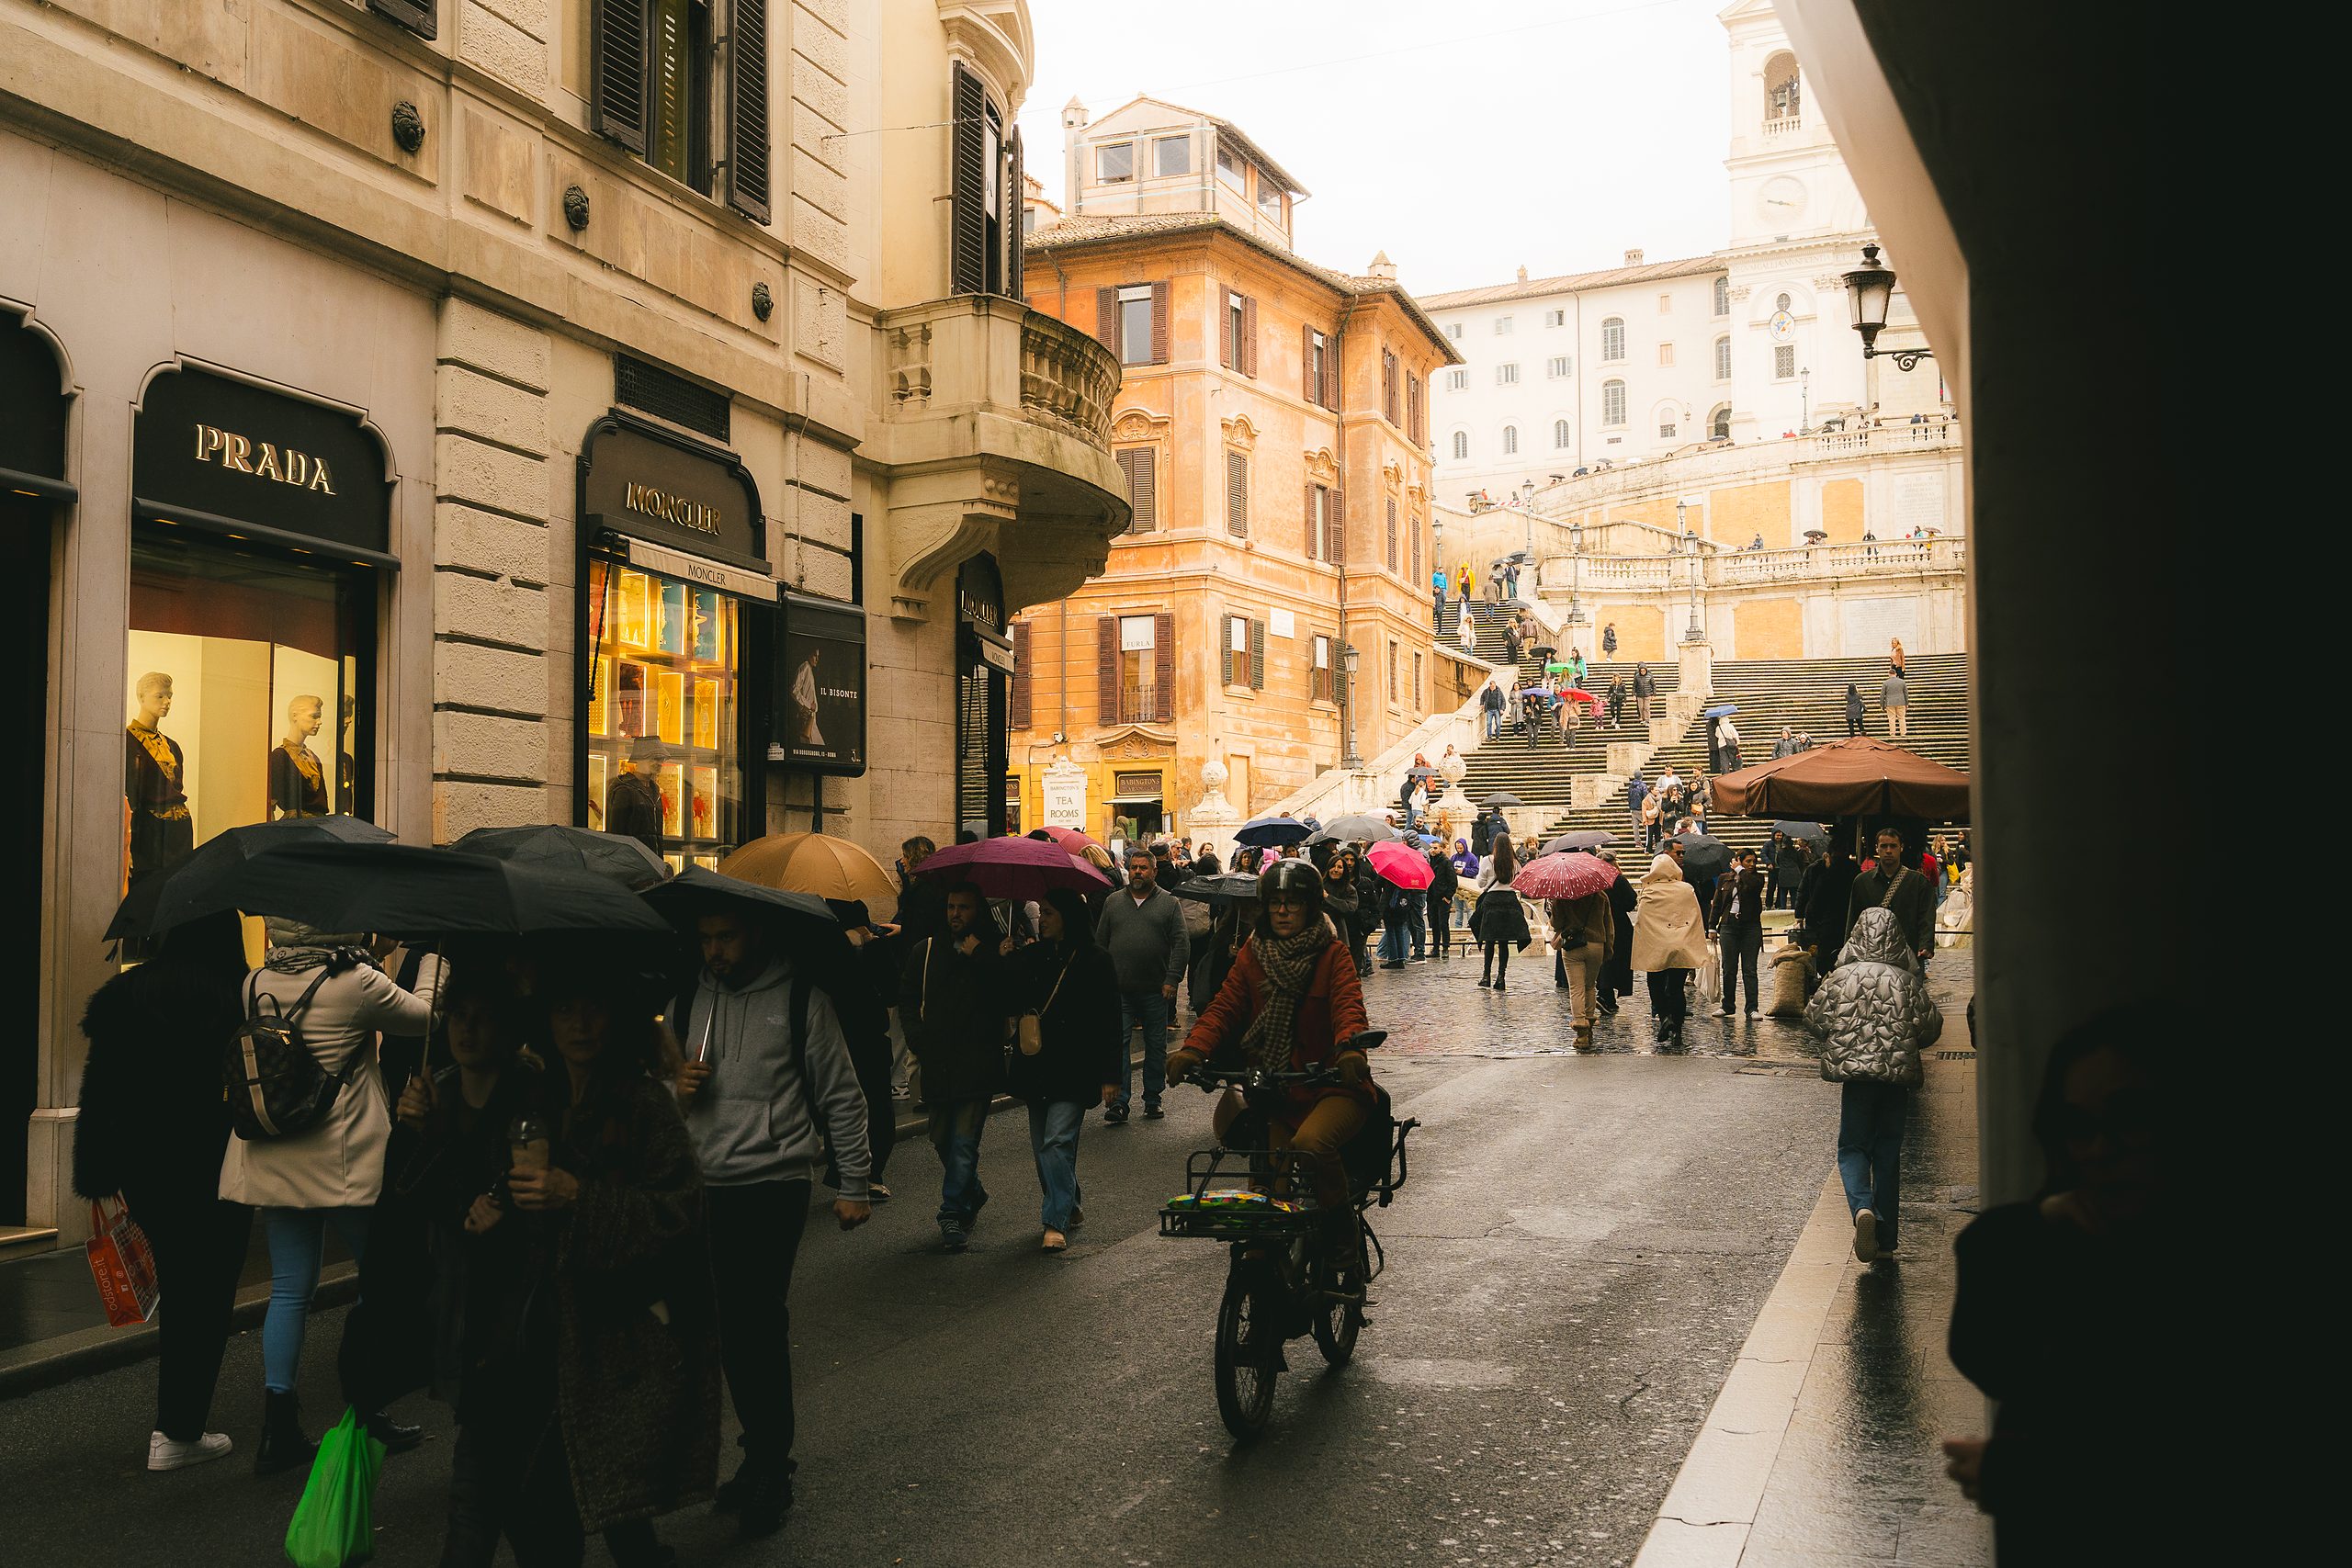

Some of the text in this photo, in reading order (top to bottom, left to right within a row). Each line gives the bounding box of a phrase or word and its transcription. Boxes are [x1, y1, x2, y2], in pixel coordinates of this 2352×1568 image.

[196, 423, 337, 495] PRADA
[627, 481, 721, 536] MONCLER
[688, 564, 726, 586] MONCLER
[820, 687, 858, 699] IL BISONTE
[1056, 796, 1073, 805] TEA
[1050, 809, 1080, 818] ROOMS
[94, 1257, 118, 1311] odstore.it
